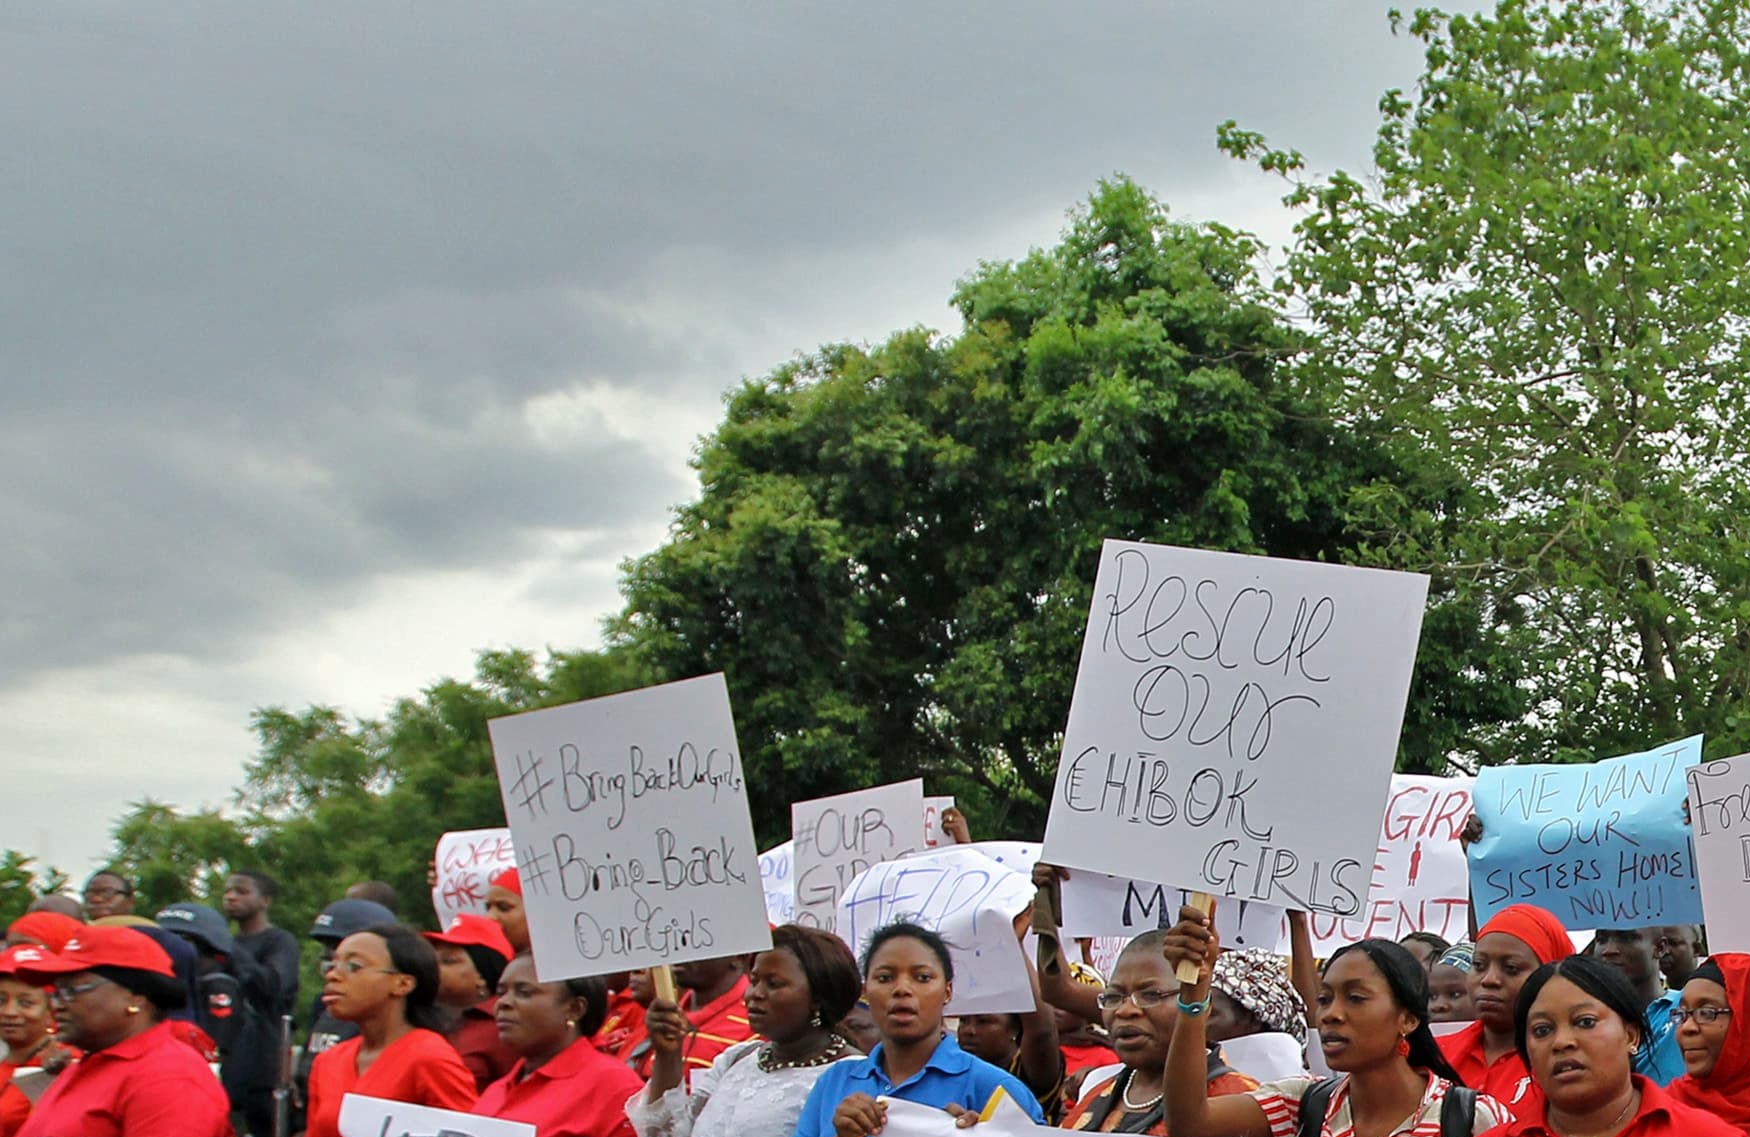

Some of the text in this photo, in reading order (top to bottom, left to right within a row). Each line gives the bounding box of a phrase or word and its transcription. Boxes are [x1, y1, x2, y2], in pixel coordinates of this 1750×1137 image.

[1065, 746, 1272, 840] CHIBOK
[1500, 747, 1689, 820] WE WANT
[1537, 811, 1641, 855] OUR
[1202, 840, 1362, 915] GIRLS
[1486, 836, 1697, 905] SISTERS HOME!
[1569, 886, 1664, 922] NOW!!
